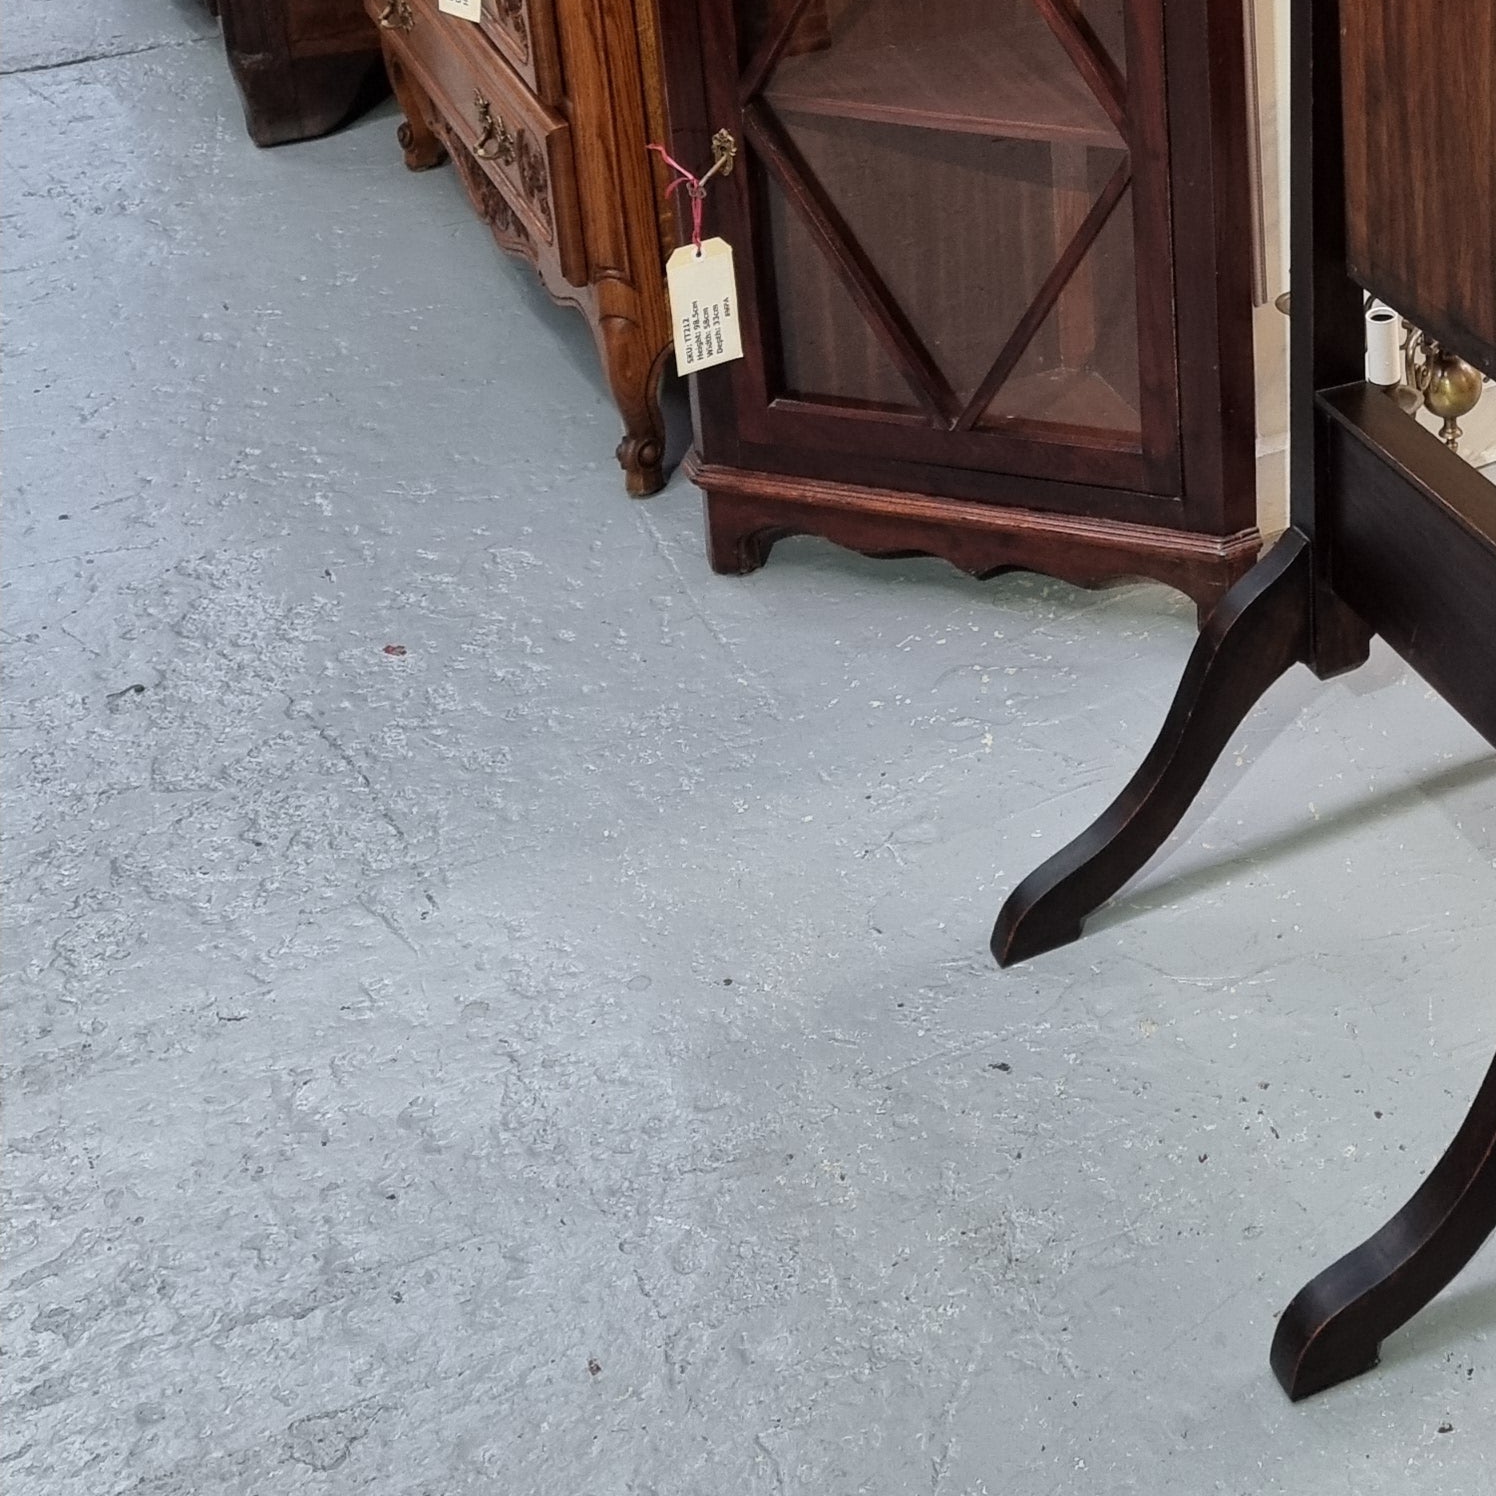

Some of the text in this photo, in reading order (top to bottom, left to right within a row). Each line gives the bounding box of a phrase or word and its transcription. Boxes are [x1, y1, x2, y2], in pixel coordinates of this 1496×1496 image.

[682, 318, 694, 363] SKU: TT212
[694, 330, 704, 361] Height:
[702, 307, 714, 359] Width: 58cm
[714, 327, 724, 355] Depth:
